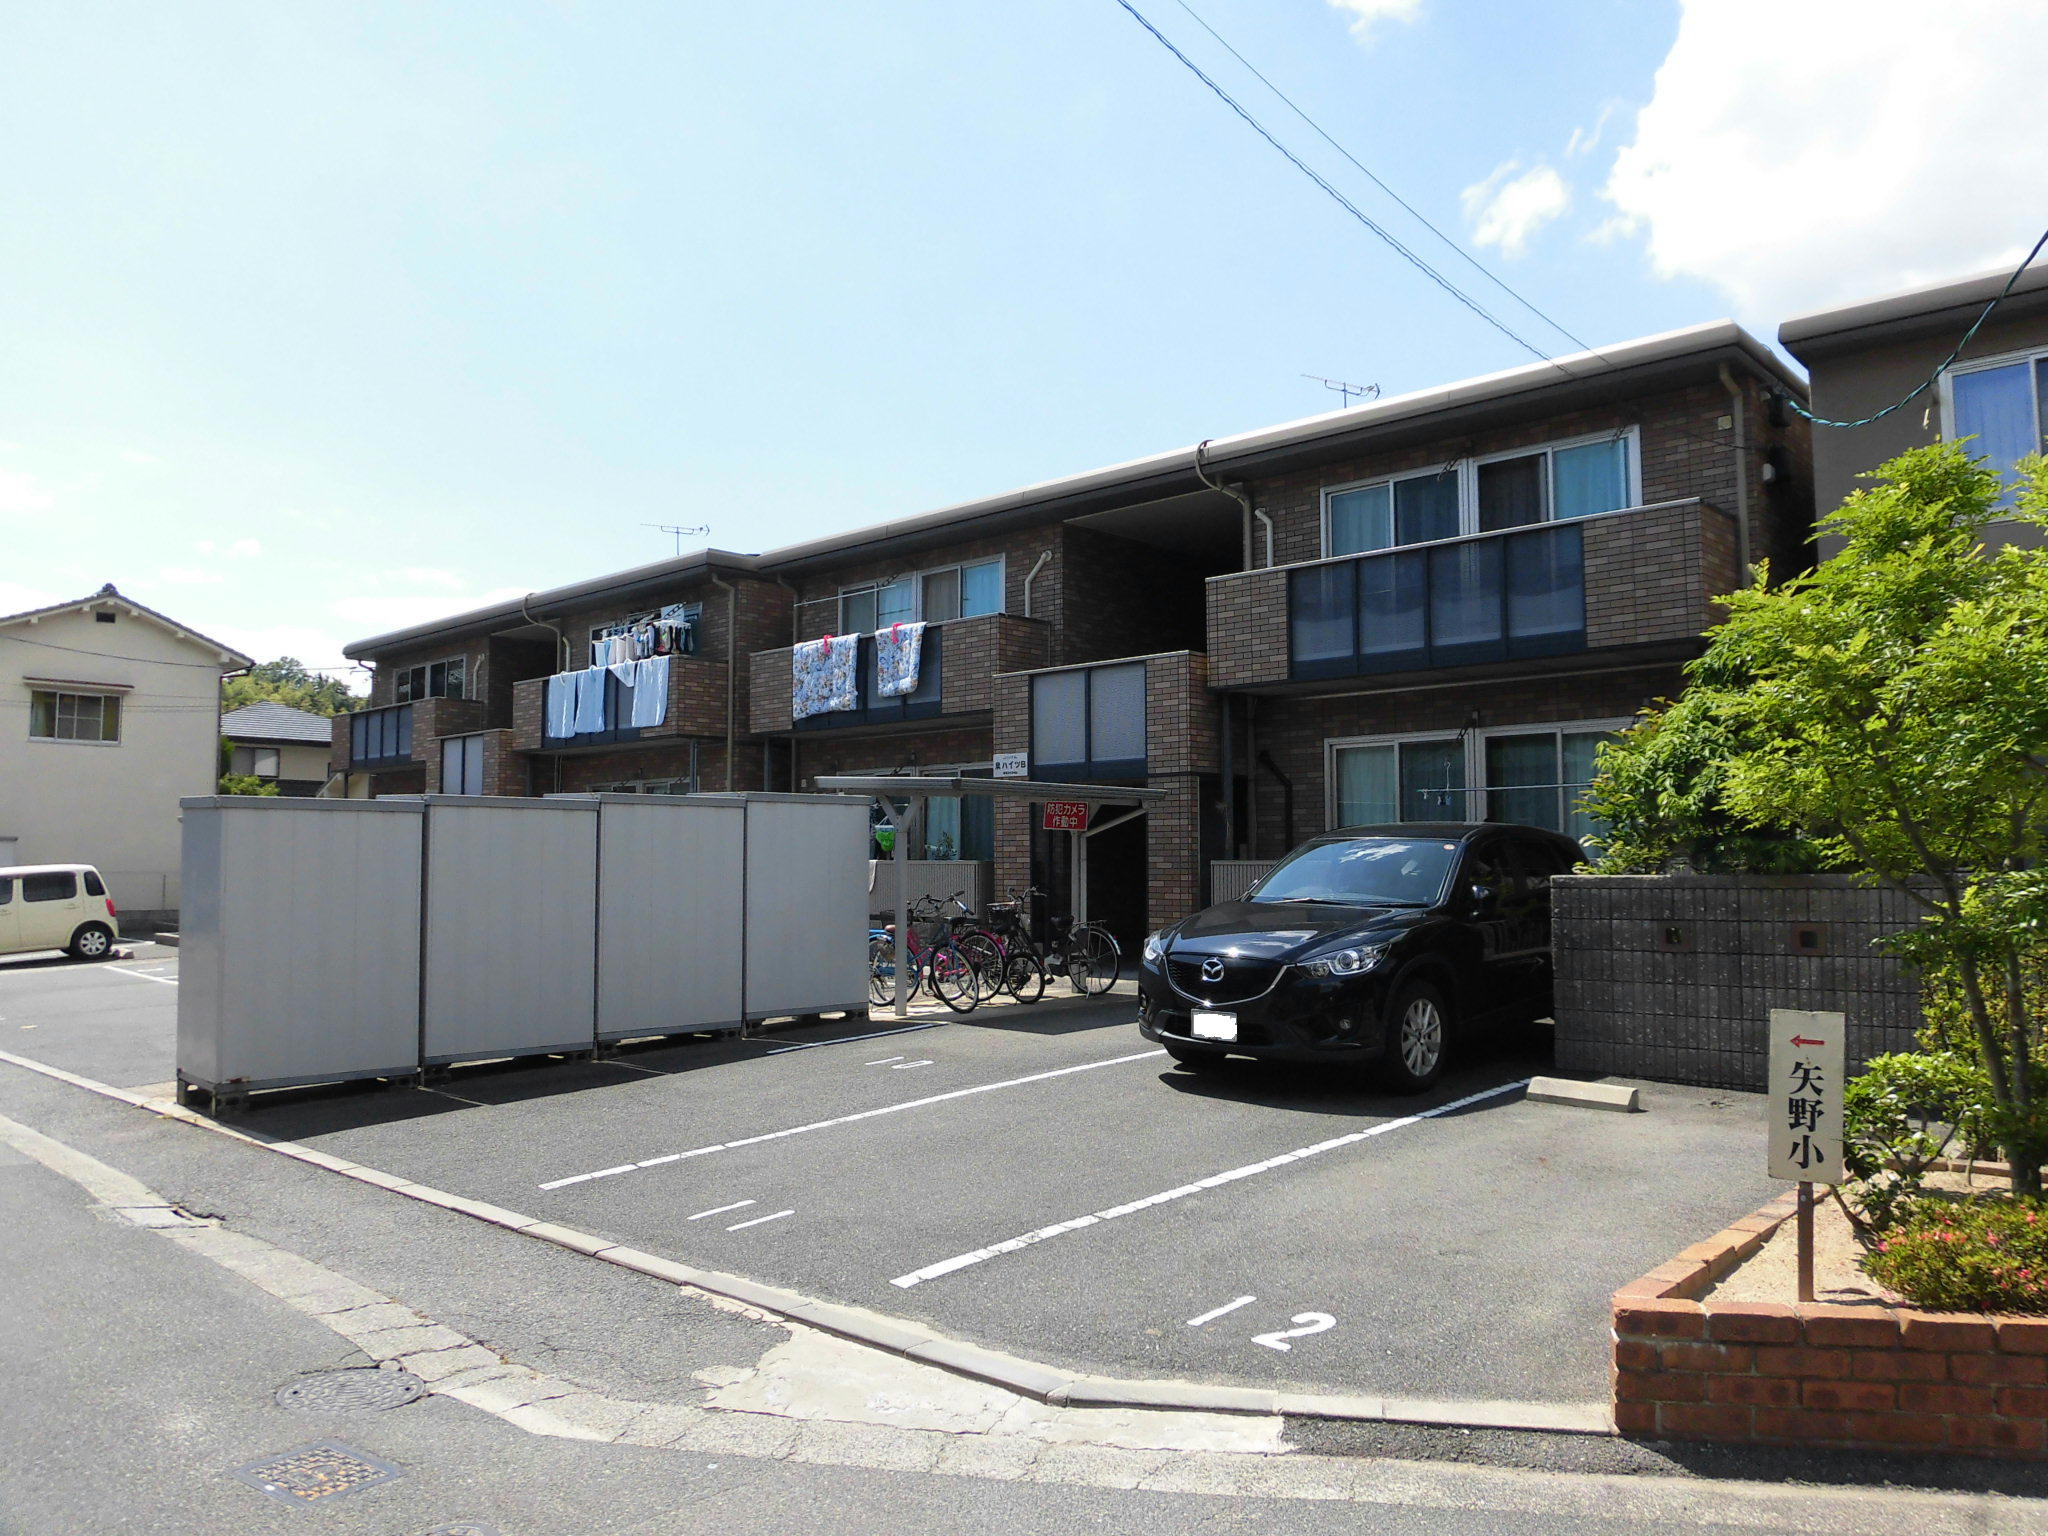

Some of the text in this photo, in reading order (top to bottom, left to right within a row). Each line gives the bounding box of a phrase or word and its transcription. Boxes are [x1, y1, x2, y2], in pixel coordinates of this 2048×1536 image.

[1046, 803, 1085, 815] 防犯カメラ
[1053, 815, 1078, 828] 作動中
[1788, 1061, 1825, 1169] 矢野小
[1186, 1295, 1338, 1352] 12
